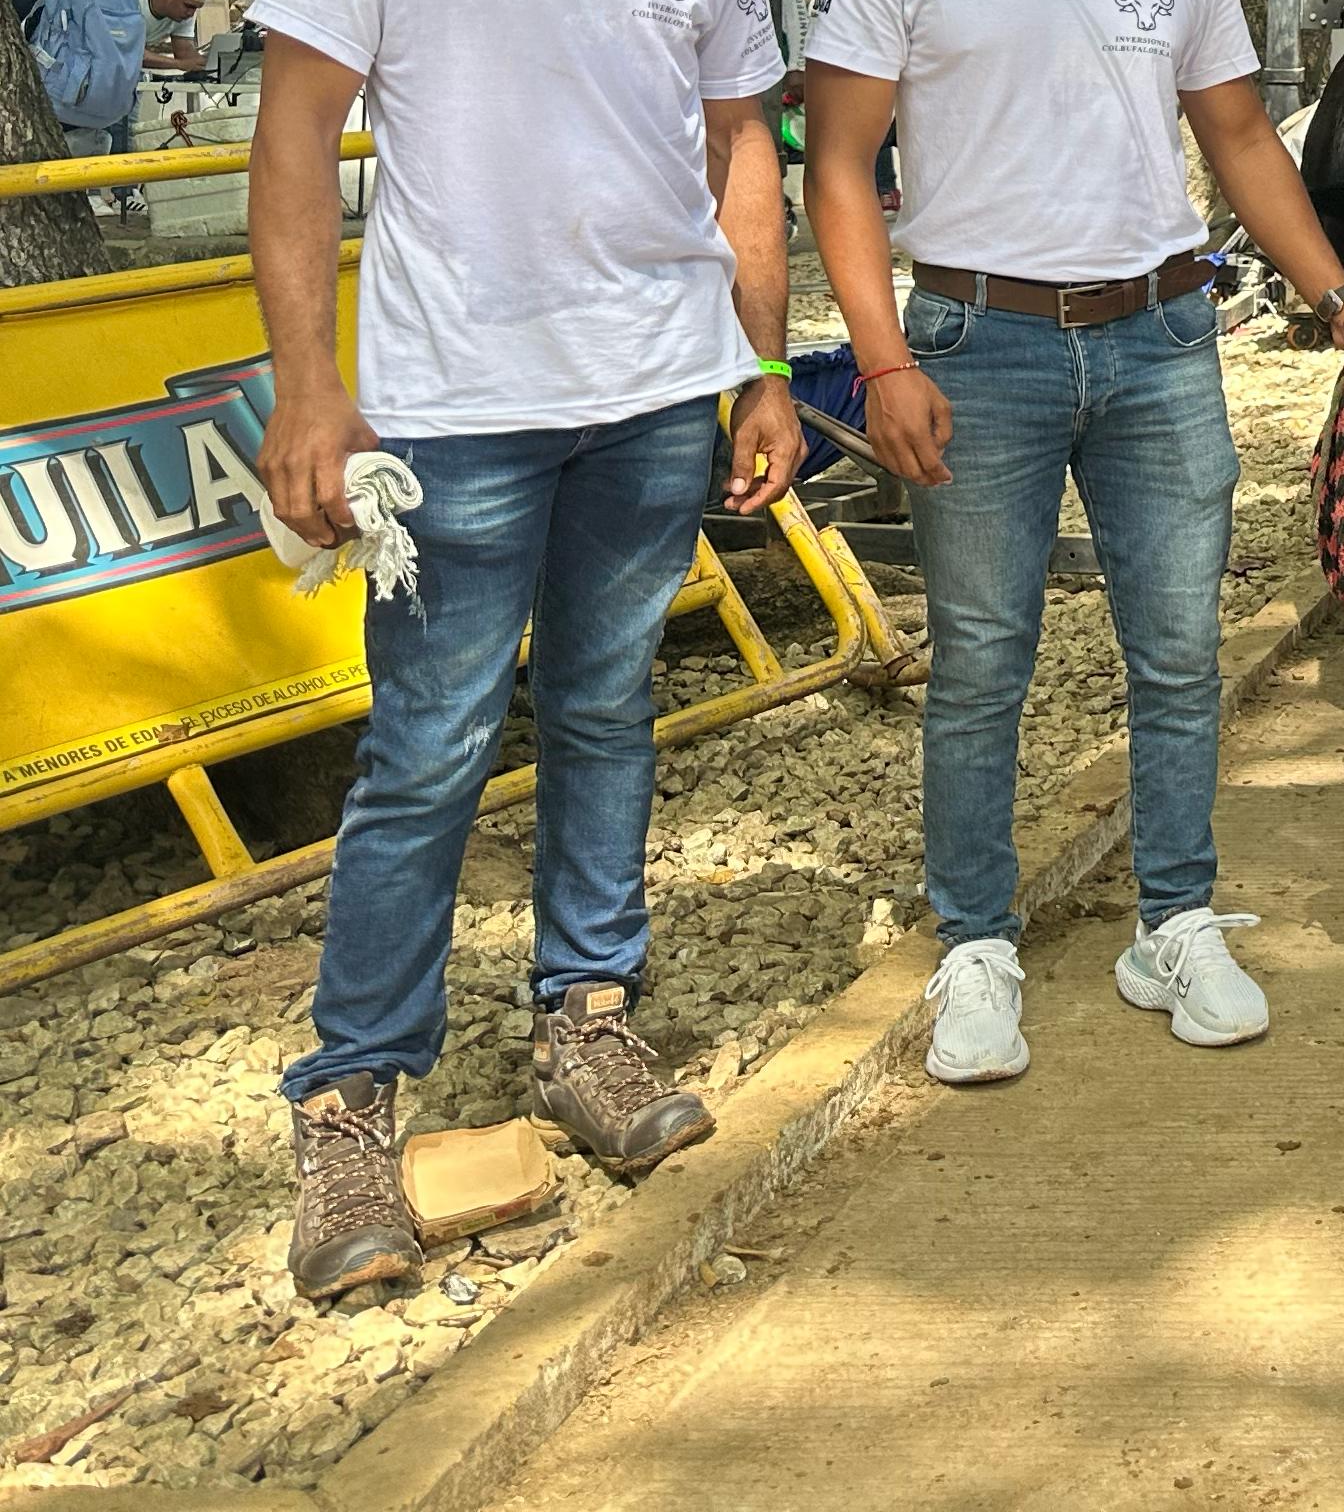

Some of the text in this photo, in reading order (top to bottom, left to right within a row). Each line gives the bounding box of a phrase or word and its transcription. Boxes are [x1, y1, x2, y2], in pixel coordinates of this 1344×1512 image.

[1102, 45, 1158, 55] COLBUFALOS
[1115, 36, 1170, 48] INVERSIONES
[0, 418, 263, 572] UILA
[3, 769, 17, 784] A
[19, 744, 103, 779] MENORES
[107, 736, 129, 754] DE
[132, 724, 163, 747] EDA
[200, 699, 253, 727] EXCESO
[254, 692, 272, 710] DE
[273, 677, 332, 703] ALCOHOL
[331, 668, 349, 685] ES
[350, 663, 370, 679] PE
